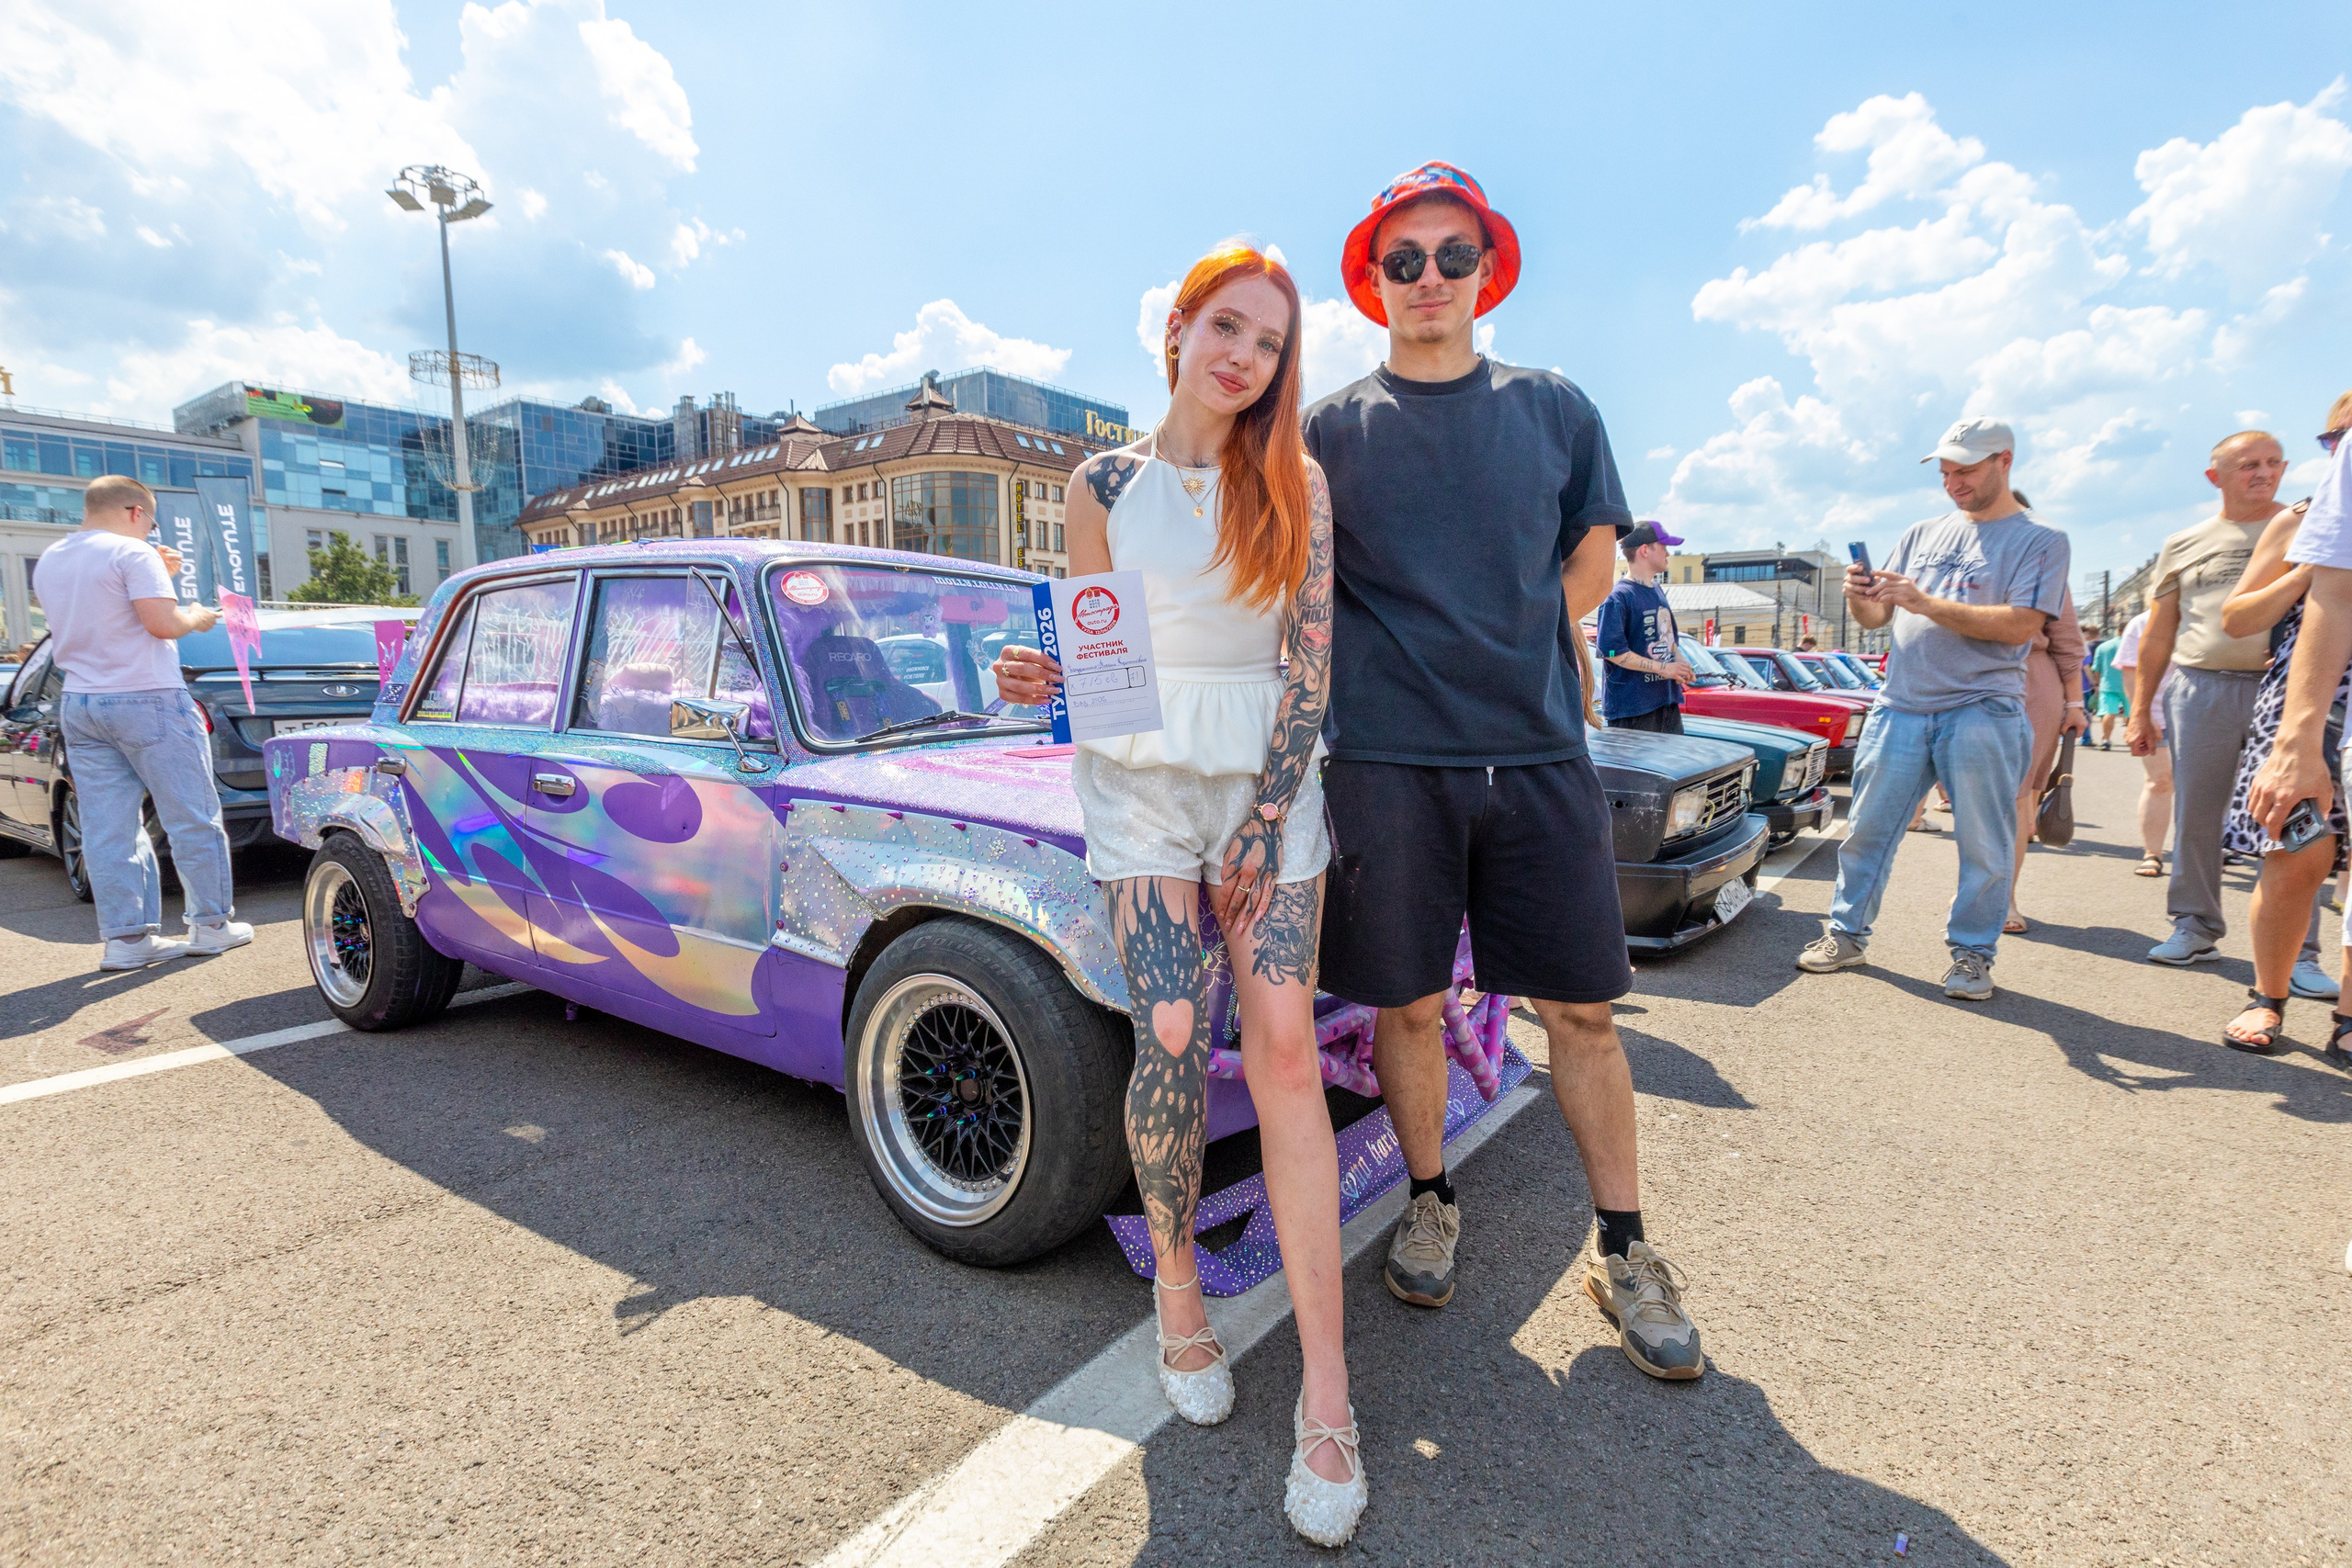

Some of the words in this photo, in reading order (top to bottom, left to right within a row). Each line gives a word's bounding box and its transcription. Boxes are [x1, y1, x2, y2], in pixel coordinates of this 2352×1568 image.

[1037, 607, 1057, 657] 2026
[1081, 626, 1093, 635] ТУЛА
[1079, 640, 1124, 651] УЧАСТНИК
[830, 651, 872, 662] RECARO
[1076, 647, 1128, 660] ФЕСТИВАЛЯ
